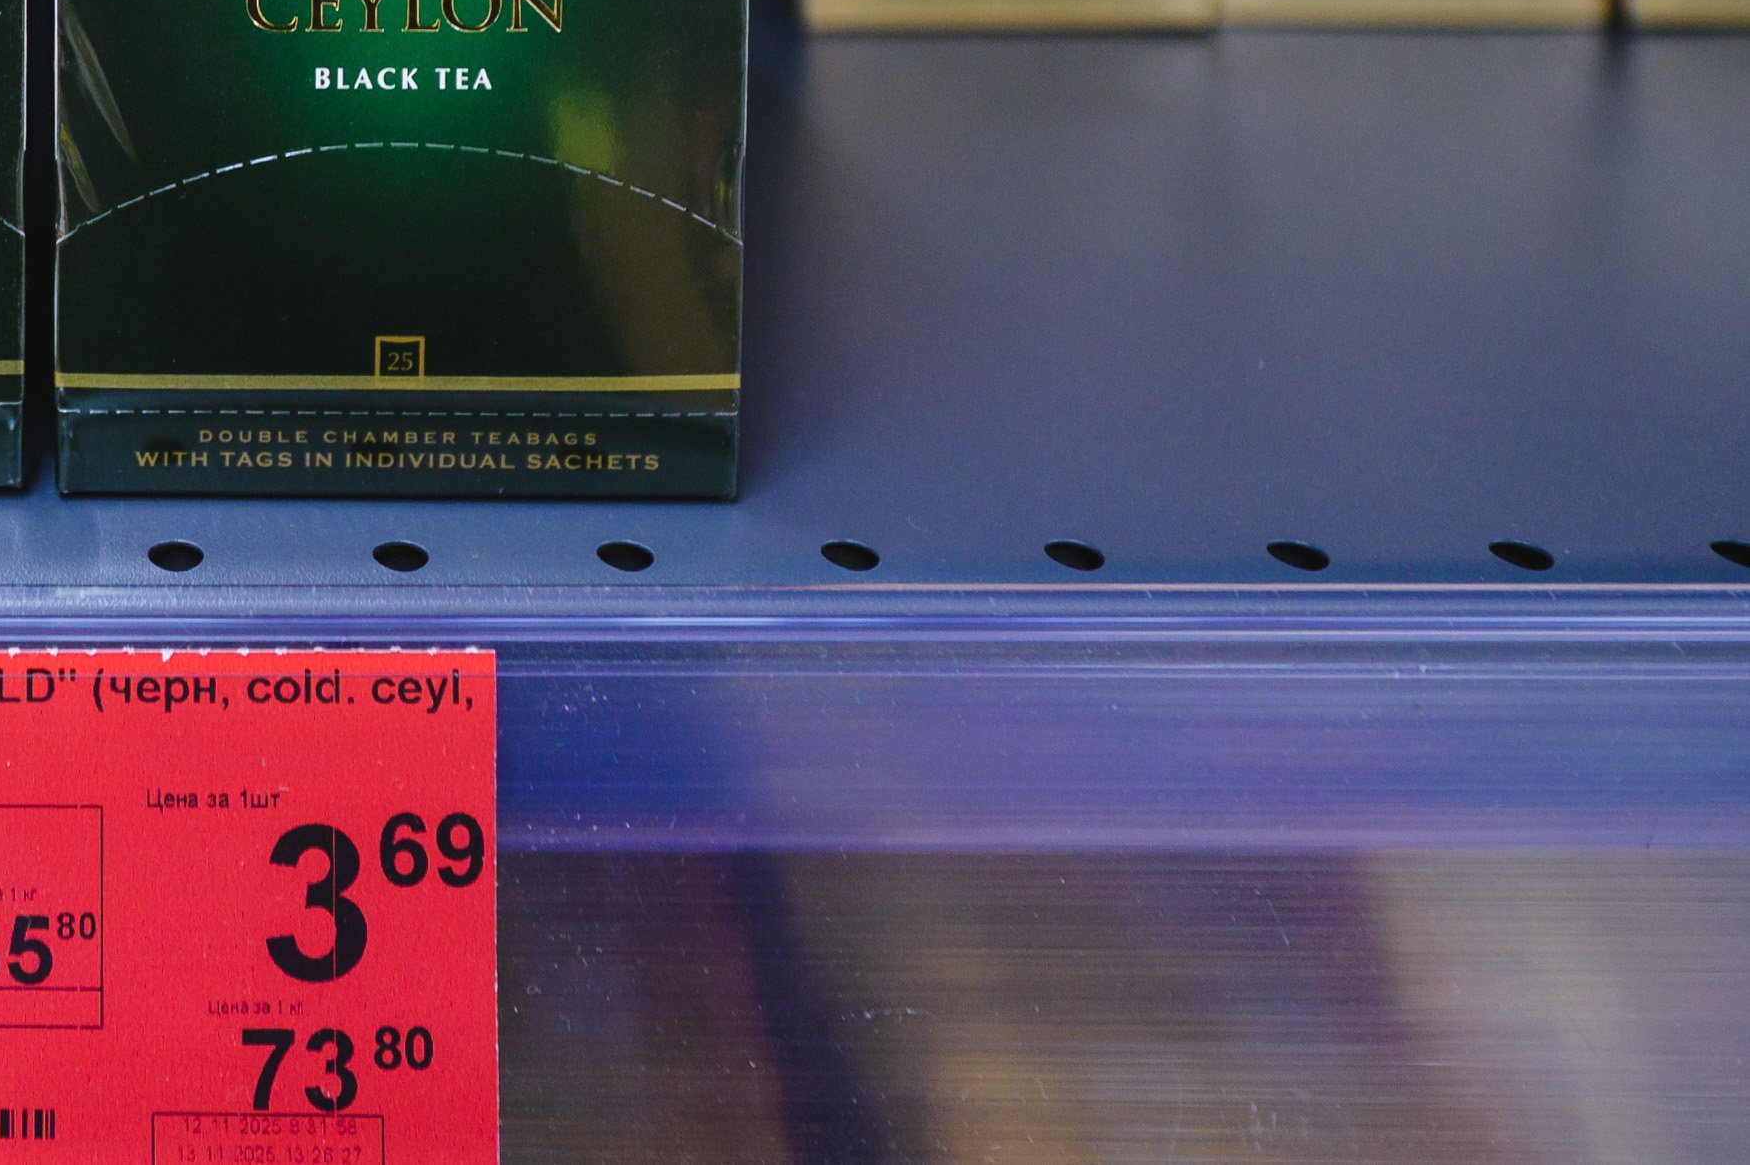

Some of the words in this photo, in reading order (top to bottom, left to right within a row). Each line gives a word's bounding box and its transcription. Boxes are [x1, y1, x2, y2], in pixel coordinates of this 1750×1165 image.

[315, 67, 419, 91] BLACK
[436, 67, 493, 91] TEA
[387, 351, 414, 371] 25
[199, 430, 310, 444] DOUBLE
[323, 430, 458, 445] CHAMBER
[472, 432, 598, 446] TEABAGS
[135, 450, 209, 468] WITH
[220, 450, 293, 469] TAGS
[305, 451, 333, 469] IN
[346, 451, 515, 470] INDIVIDUAL
[527, 452, 661, 471] SACHETS
[93, 668, 230, 713] (черн,
[146, 787, 198, 813] Цена
[207, 792, 229, 809] за
[240, 788, 281, 809] 1шт
[208, 1000, 249, 1019] Цена
